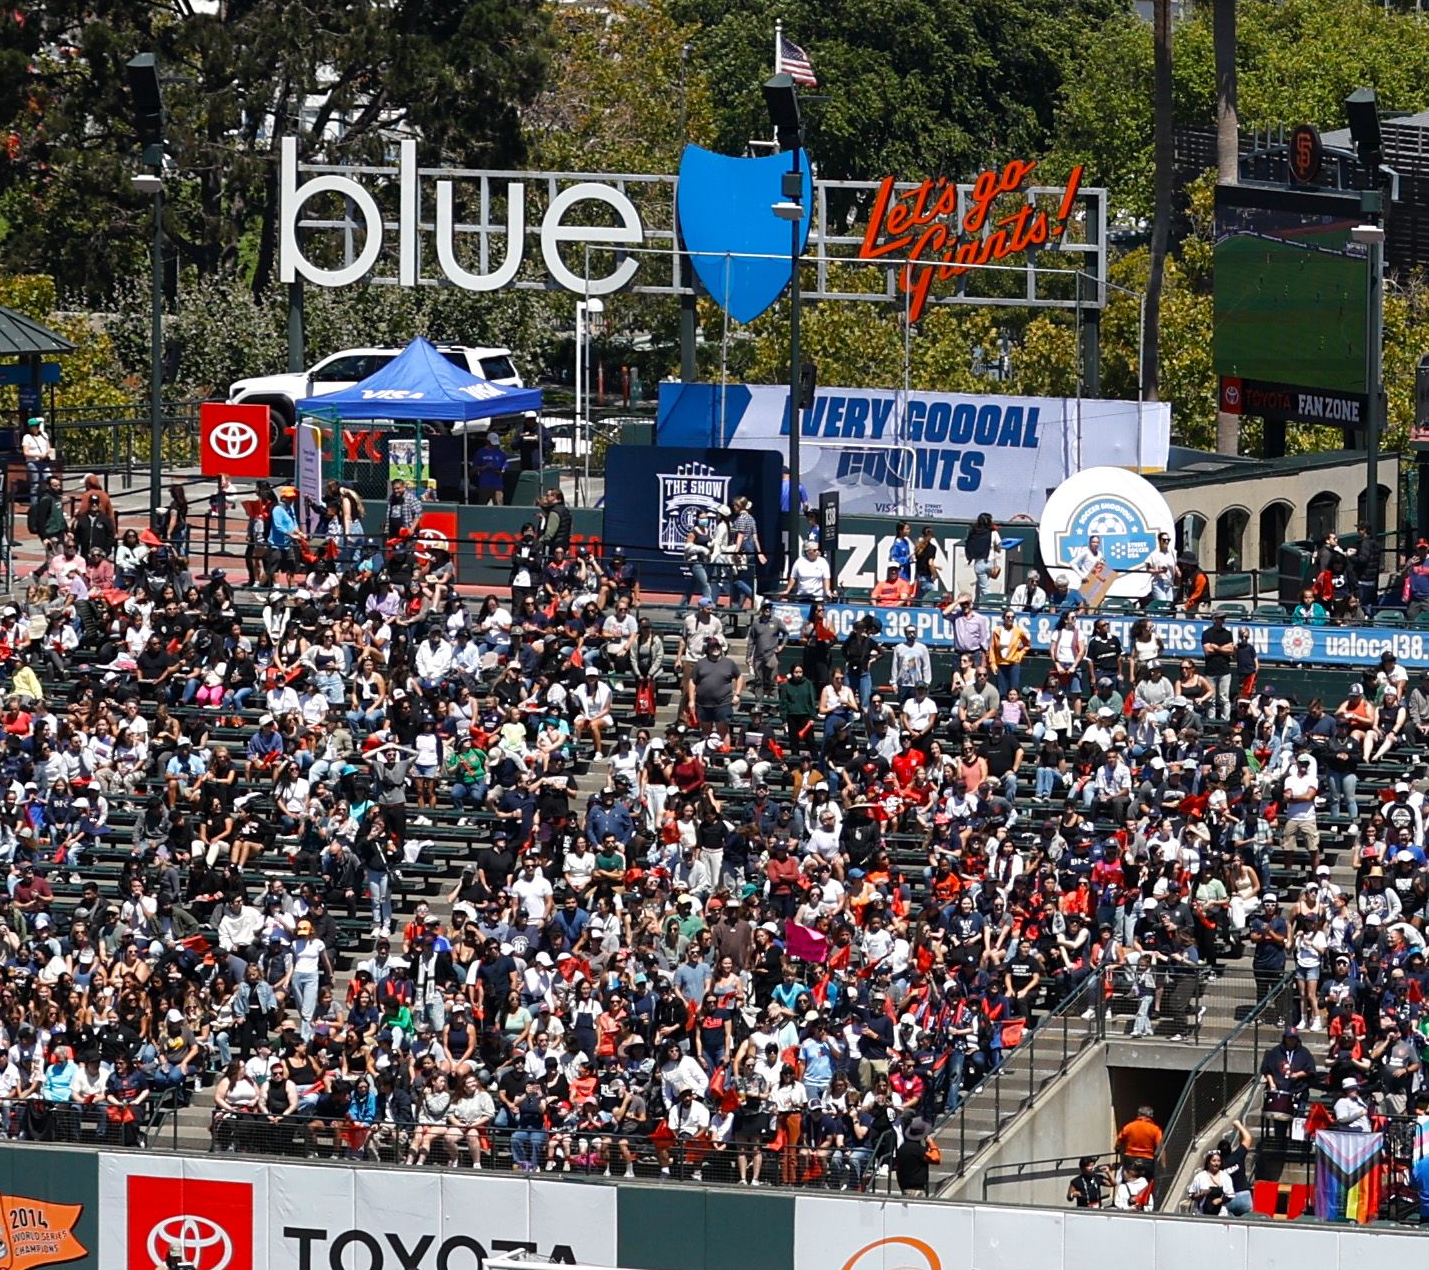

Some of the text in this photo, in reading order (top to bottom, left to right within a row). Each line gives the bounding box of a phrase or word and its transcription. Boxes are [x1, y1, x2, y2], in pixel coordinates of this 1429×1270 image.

[279, 136, 643, 295] blue
[858, 159, 1038, 259] Let's go
[898, 164, 1084, 324] Giants!
[361, 389, 424, 399] VISA
[459, 383, 507, 400] VISA
[1245, 388, 1360, 423] TOYOTA FAN ZONE
[899, 401, 1041, 448] GOOOAL
[665, 479, 722, 499] THE SHOW
[10, 1209, 48, 1230] 2014
[12, 1229, 68, 1243] WORLD SERIES
[14, 1243, 60, 1257] CHAMPIONS
